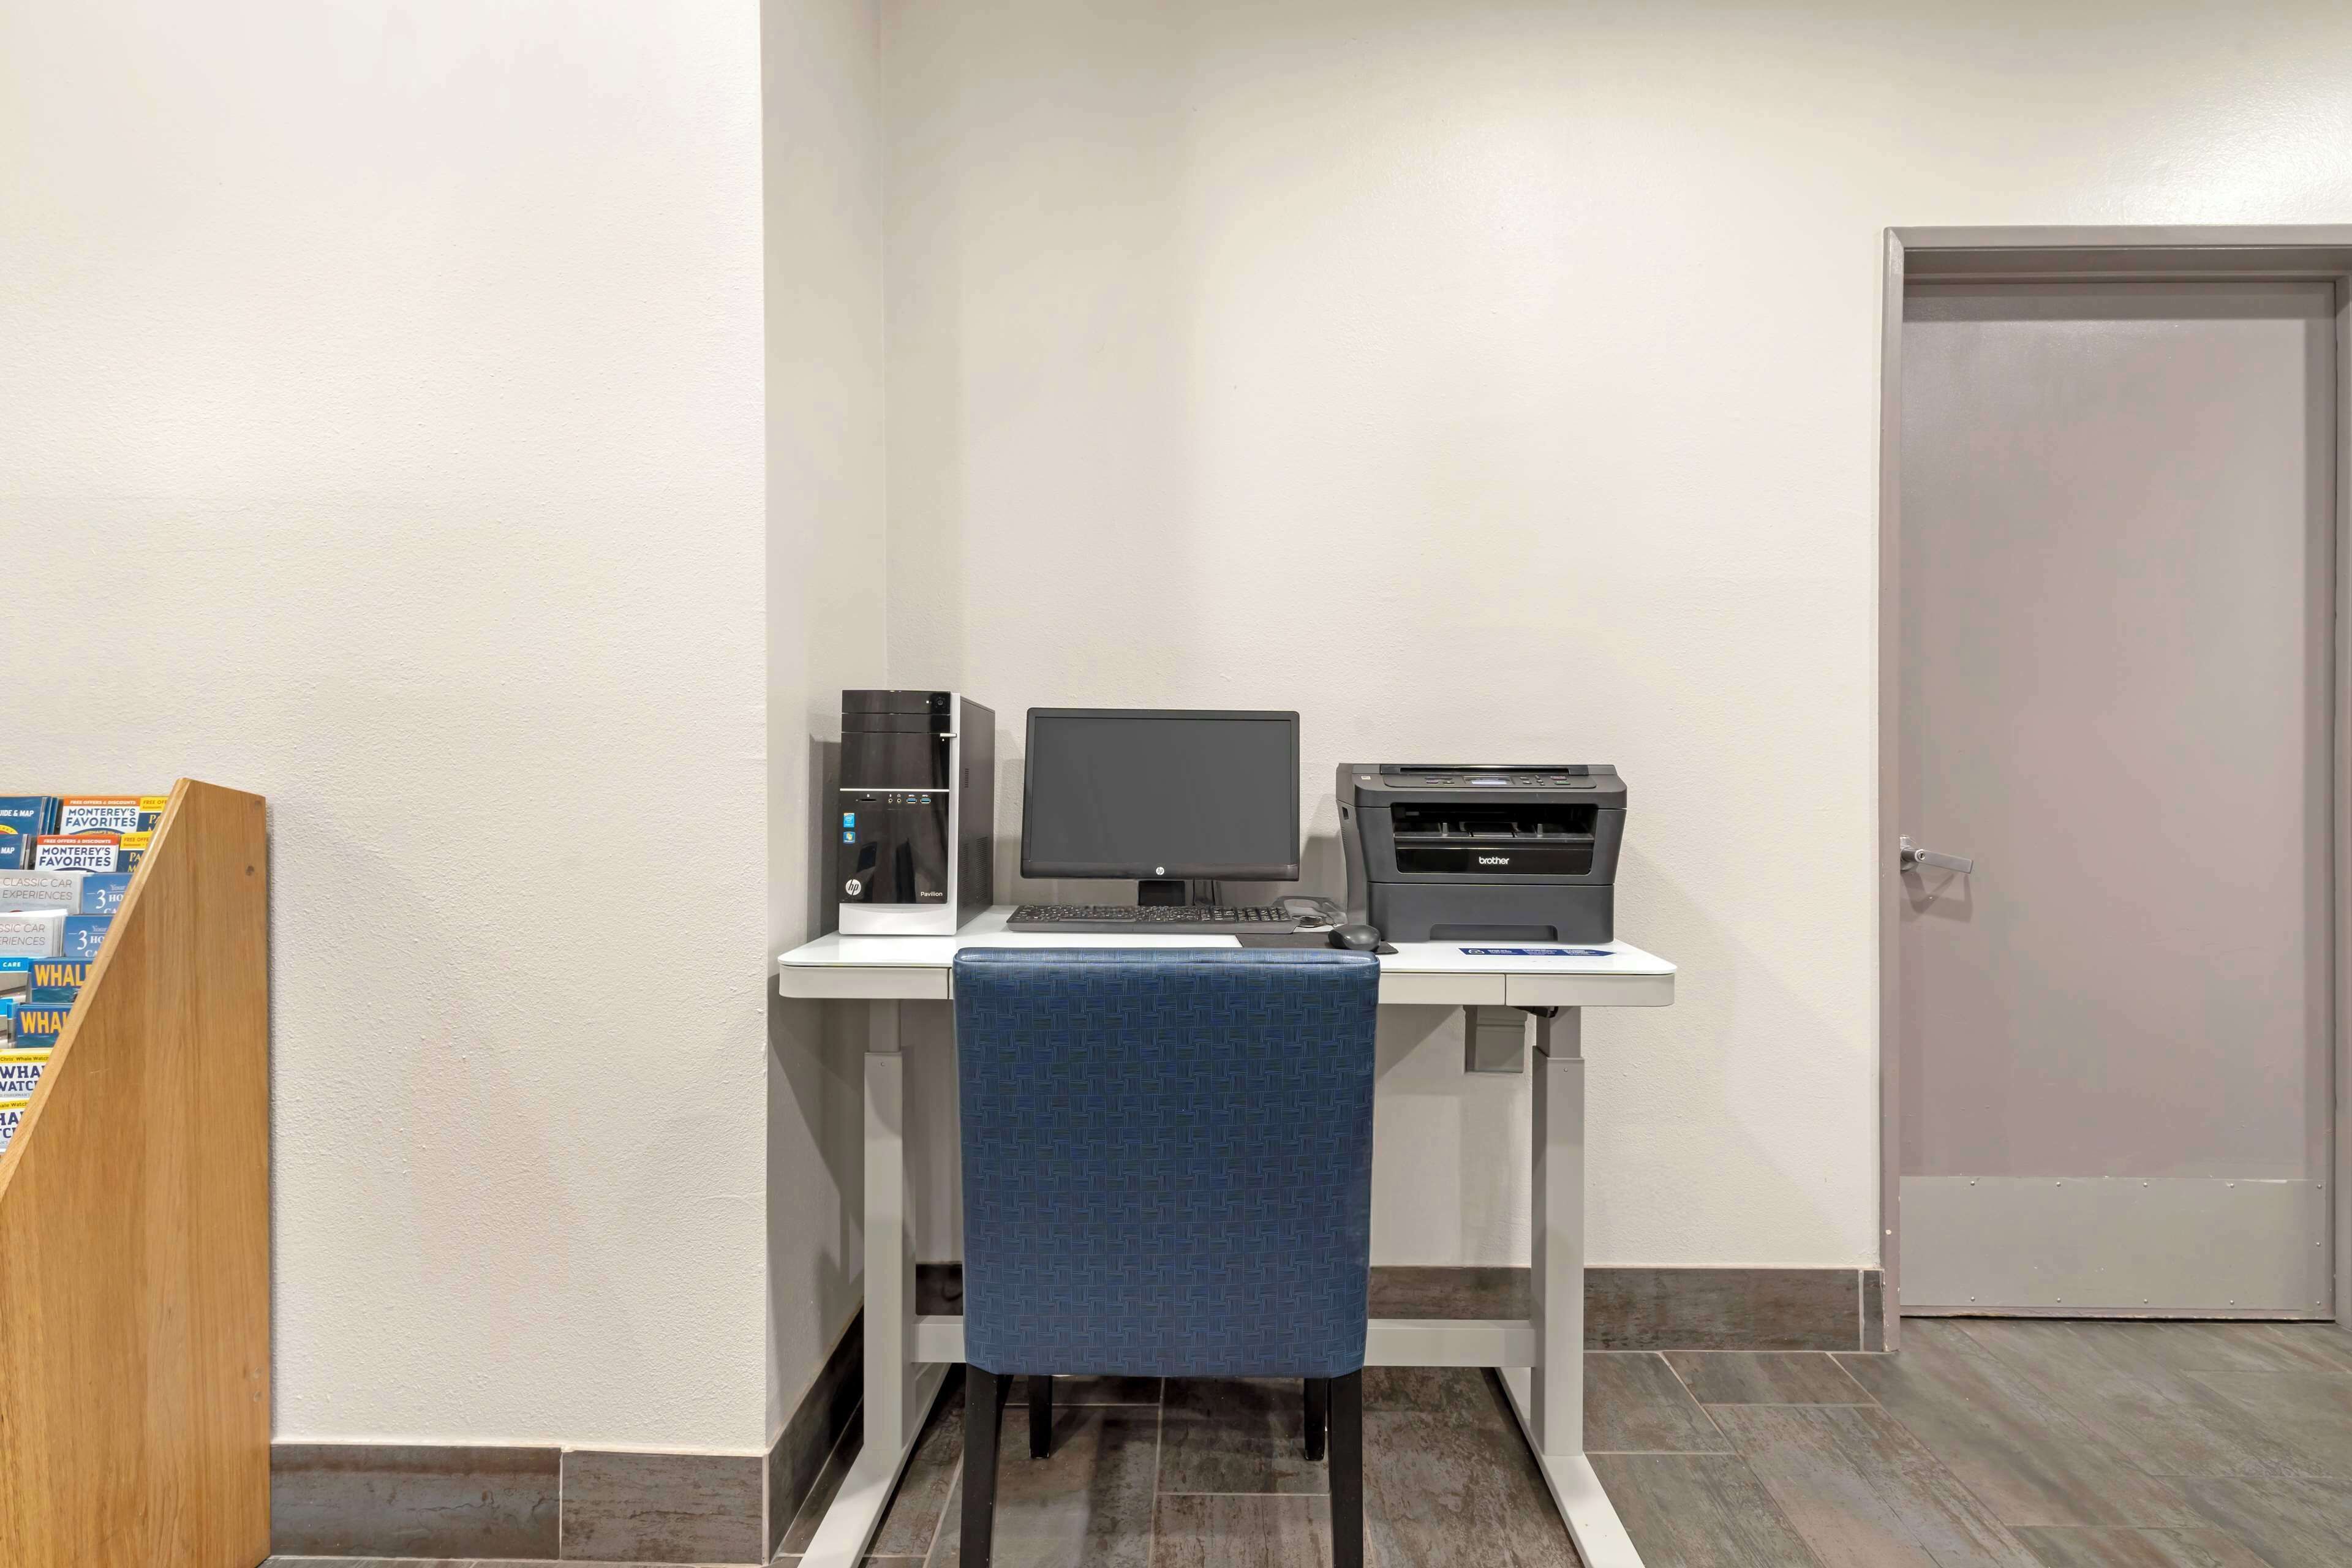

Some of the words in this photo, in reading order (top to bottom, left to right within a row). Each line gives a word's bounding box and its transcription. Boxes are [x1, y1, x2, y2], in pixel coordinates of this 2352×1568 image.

[68, 808, 136, 816] MONTEREY'S
[66, 817, 137, 827] FAVORITES
[42, 847, 111, 856] MONTEREY'S
[39, 856, 111, 866] FAVORITES
[3, 878, 48, 887] CLASSIC
[51, 879, 72, 888] CAR
[847, 880, 860, 895] hp
[2, 890, 73, 900] EXPERIENCES
[96, 889, 106, 909] 3
[24, 924, 45, 933] CAR
[77, 930, 88, 950] 3
